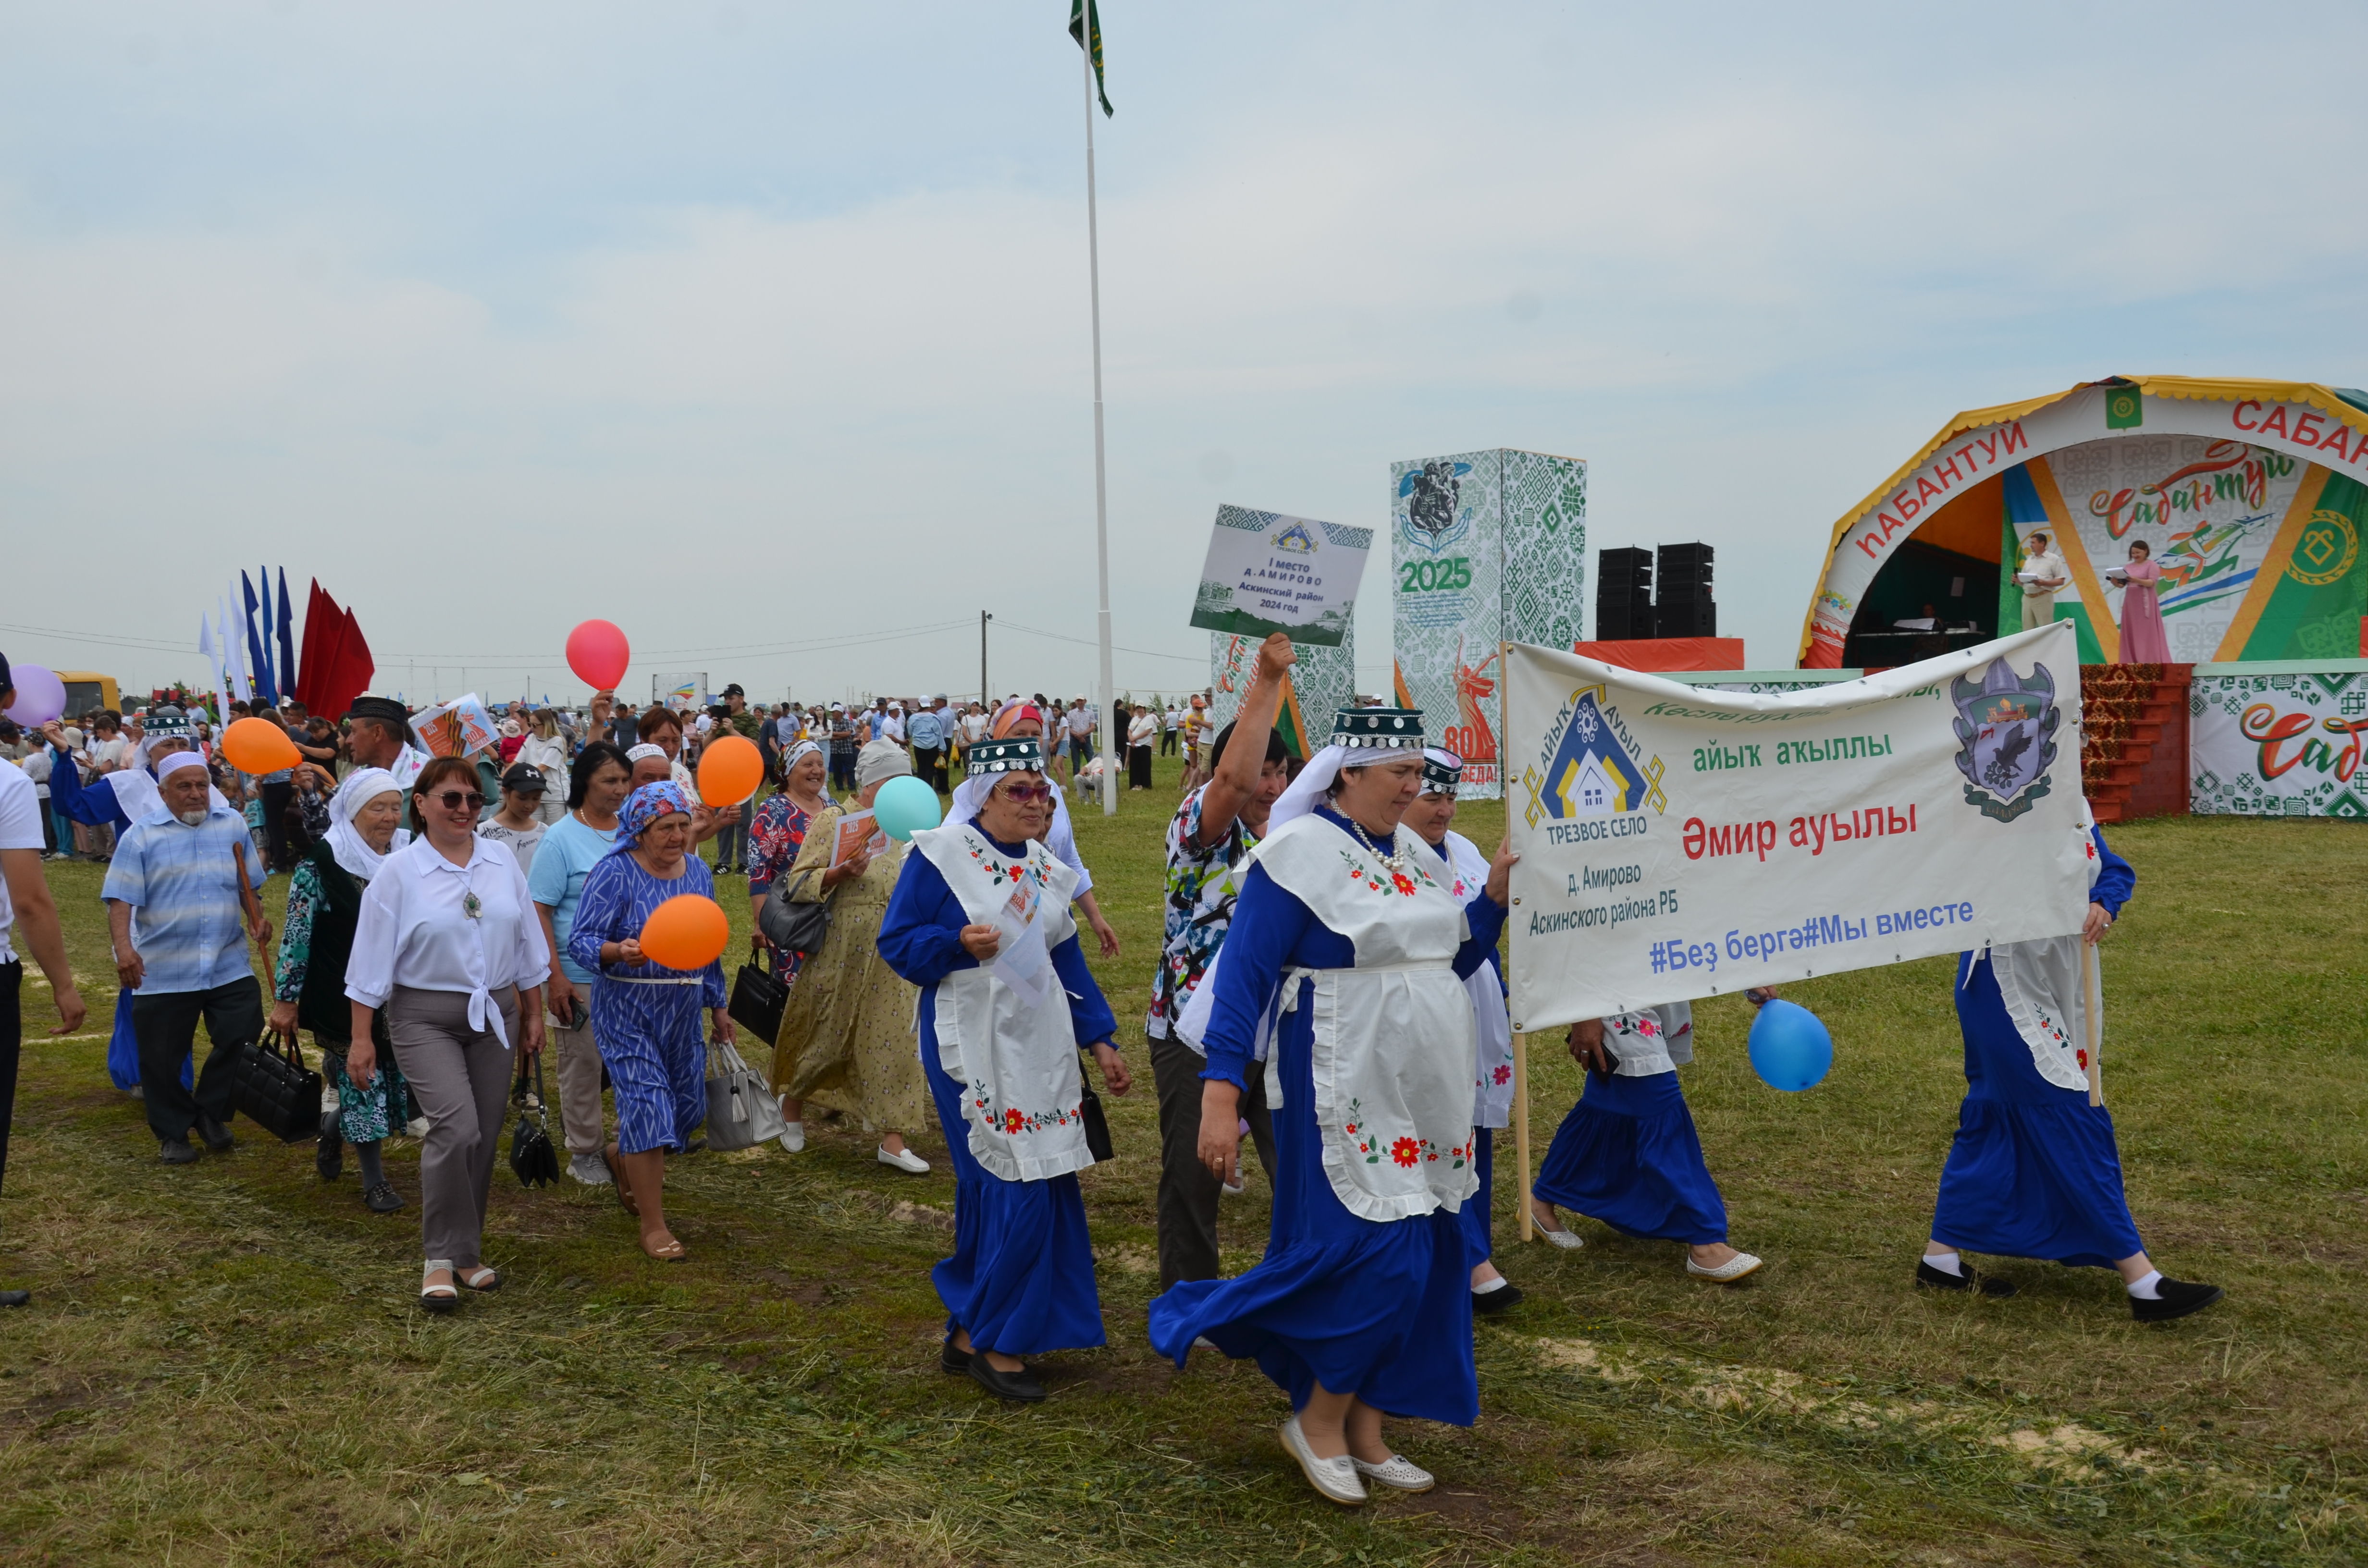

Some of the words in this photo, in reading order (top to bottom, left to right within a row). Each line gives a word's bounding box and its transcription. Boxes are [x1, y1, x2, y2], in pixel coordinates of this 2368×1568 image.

[2089, 440, 2294, 540] Сабантуй
[1276, 561, 1310, 573] место
[1400, 557, 1471, 592] 2025
[1239, 582, 1292, 598] Аскинский
[1296, 591, 1323, 601] район
[1260, 599, 1281, 609] 2024
[1283, 604, 1298, 614] год
[423, 722, 438, 736] 2025
[465, 731, 480, 744] 80
[1445, 726, 1473, 759] 80
[1604, 706, 1641, 761] АУЫЛ
[471, 736, 491, 750] ПОБЕДА!
[2240, 703, 2368, 783] Саб
[1460, 766, 1497, 785] БЕДА!
[846, 821, 859, 834] 2025
[1547, 820, 1608, 845] ТРЕЗВОЕ
[1611, 816, 1647, 836] СЕЛО
[1683, 817, 1776, 862] Әмир
[1788, 804, 1916, 856] ауылы
[1583, 865, 1641, 892] Амирово
[1011, 893, 1022, 904] 80
[1529, 905, 1607, 936] Аскинского
[1611, 896, 1656, 929] района
[1659, 889, 1678, 915] РБ
[1876, 901, 1973, 936] вместе
